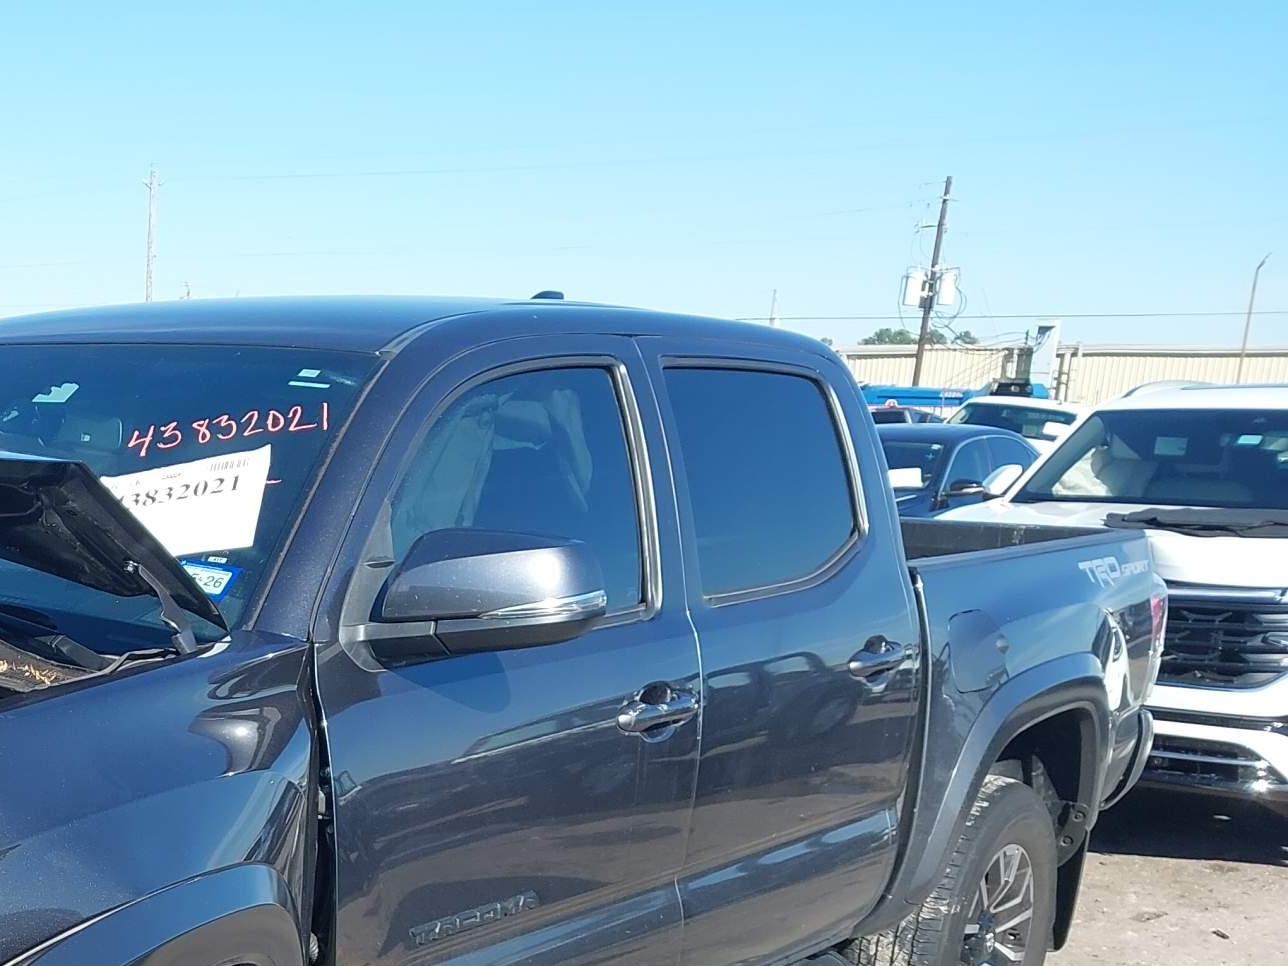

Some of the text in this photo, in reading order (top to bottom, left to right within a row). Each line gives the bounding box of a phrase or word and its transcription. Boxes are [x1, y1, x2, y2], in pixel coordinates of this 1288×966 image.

[1078, 556, 1149, 588] TRD SPORT
[409, 889, 538, 946] TACOMA
